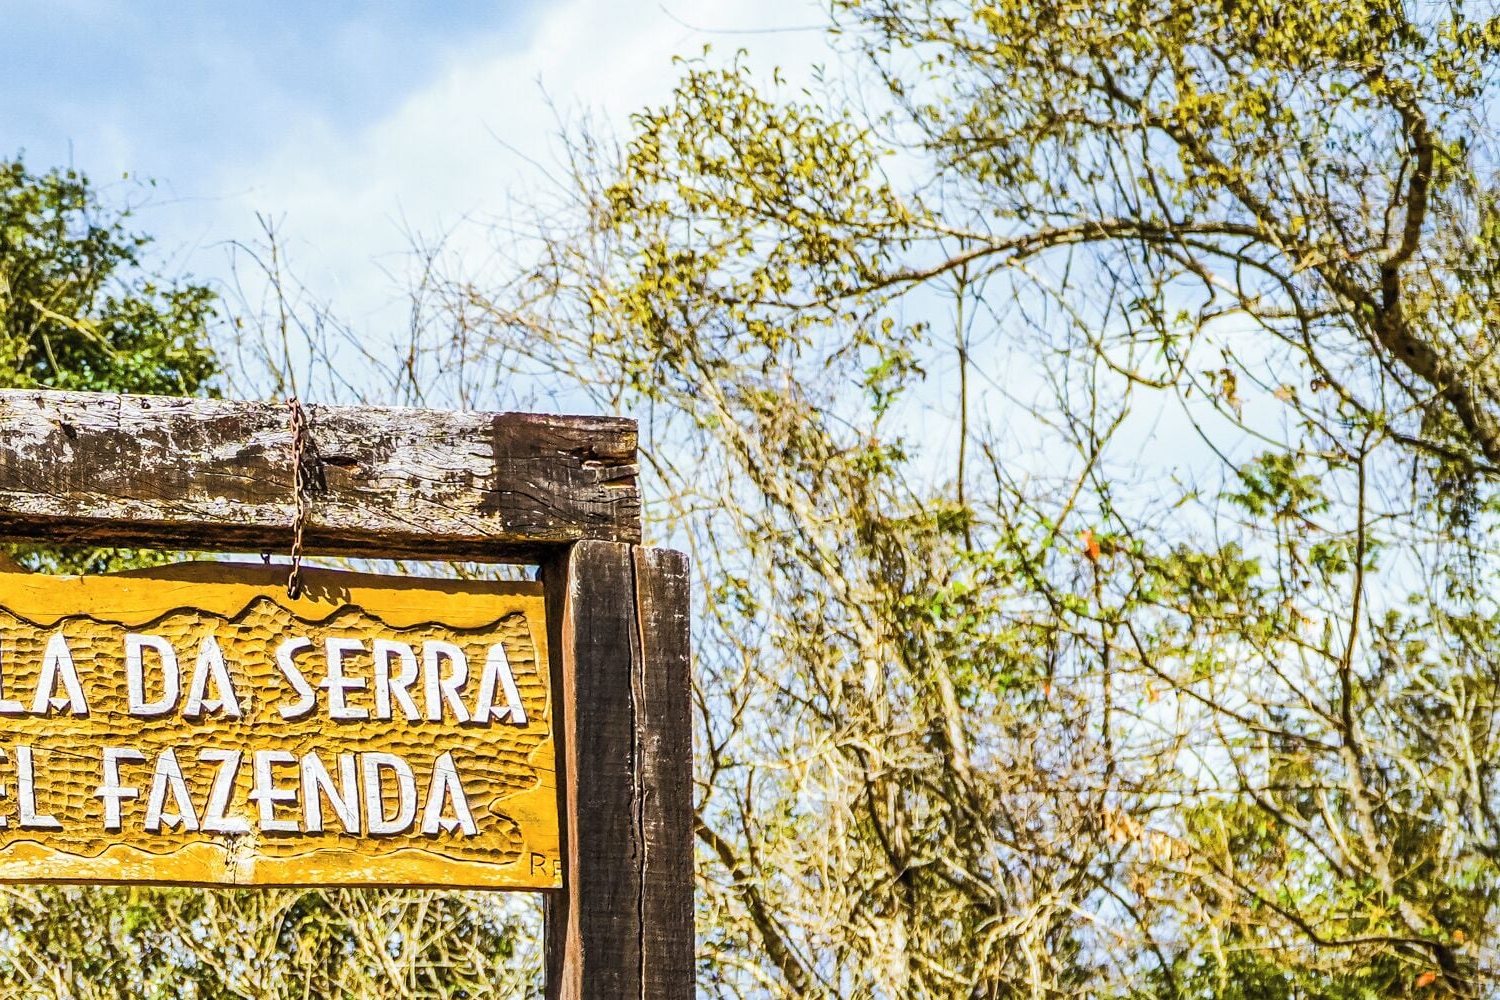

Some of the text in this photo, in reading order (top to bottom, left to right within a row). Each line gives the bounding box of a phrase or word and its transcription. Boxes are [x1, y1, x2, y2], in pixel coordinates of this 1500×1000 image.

[123, 633, 242, 718] DA
[276, 637, 528, 724] SERRA
[94, 747, 478, 835] FAZENDA
